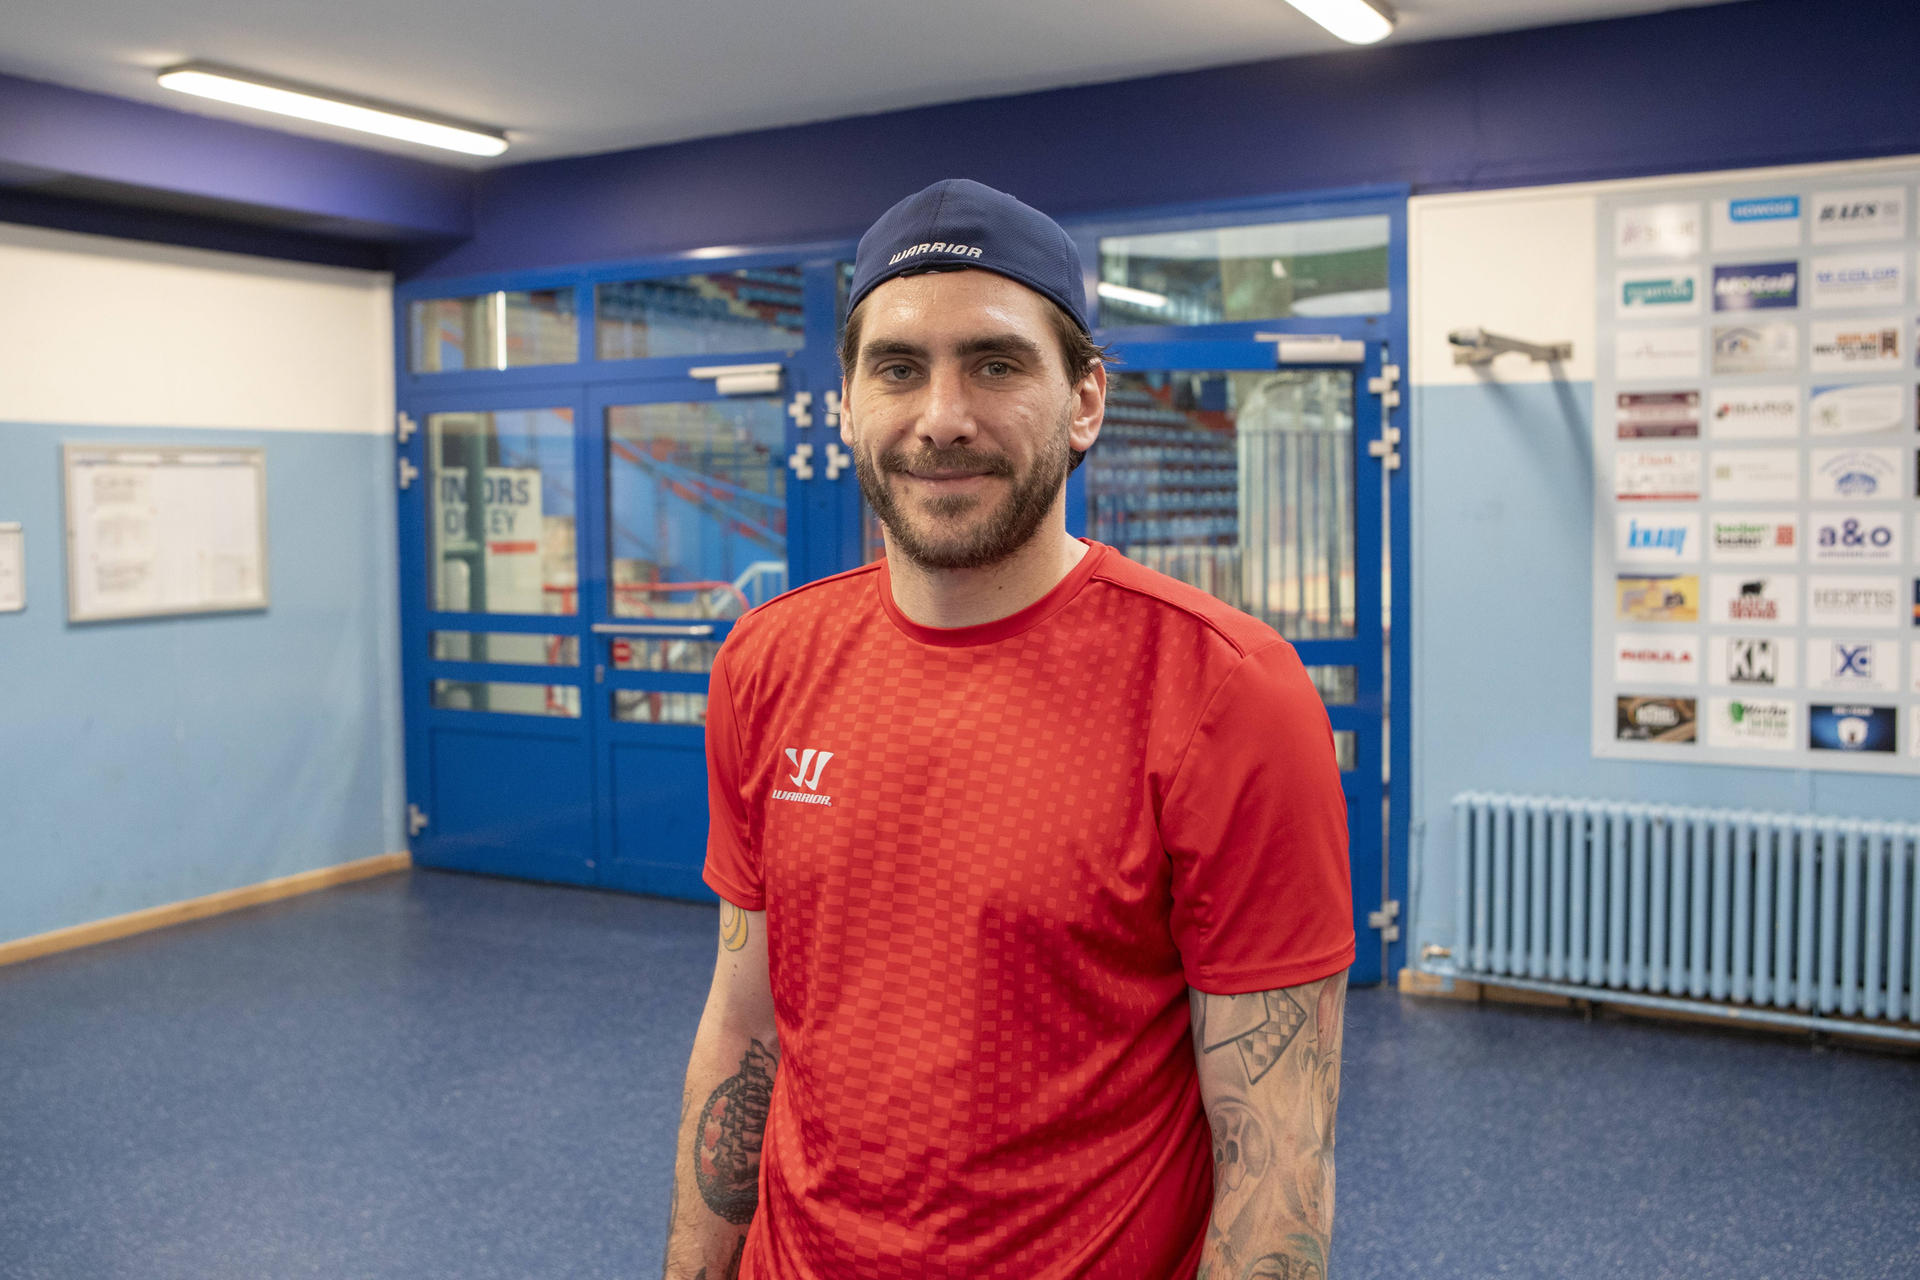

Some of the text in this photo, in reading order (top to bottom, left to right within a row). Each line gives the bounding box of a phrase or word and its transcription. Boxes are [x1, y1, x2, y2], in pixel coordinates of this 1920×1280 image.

[888, 242, 983, 265] WARRIOR
[1818, 517, 1892, 547] a&o
[772, 789, 832, 806] WARRIOR
